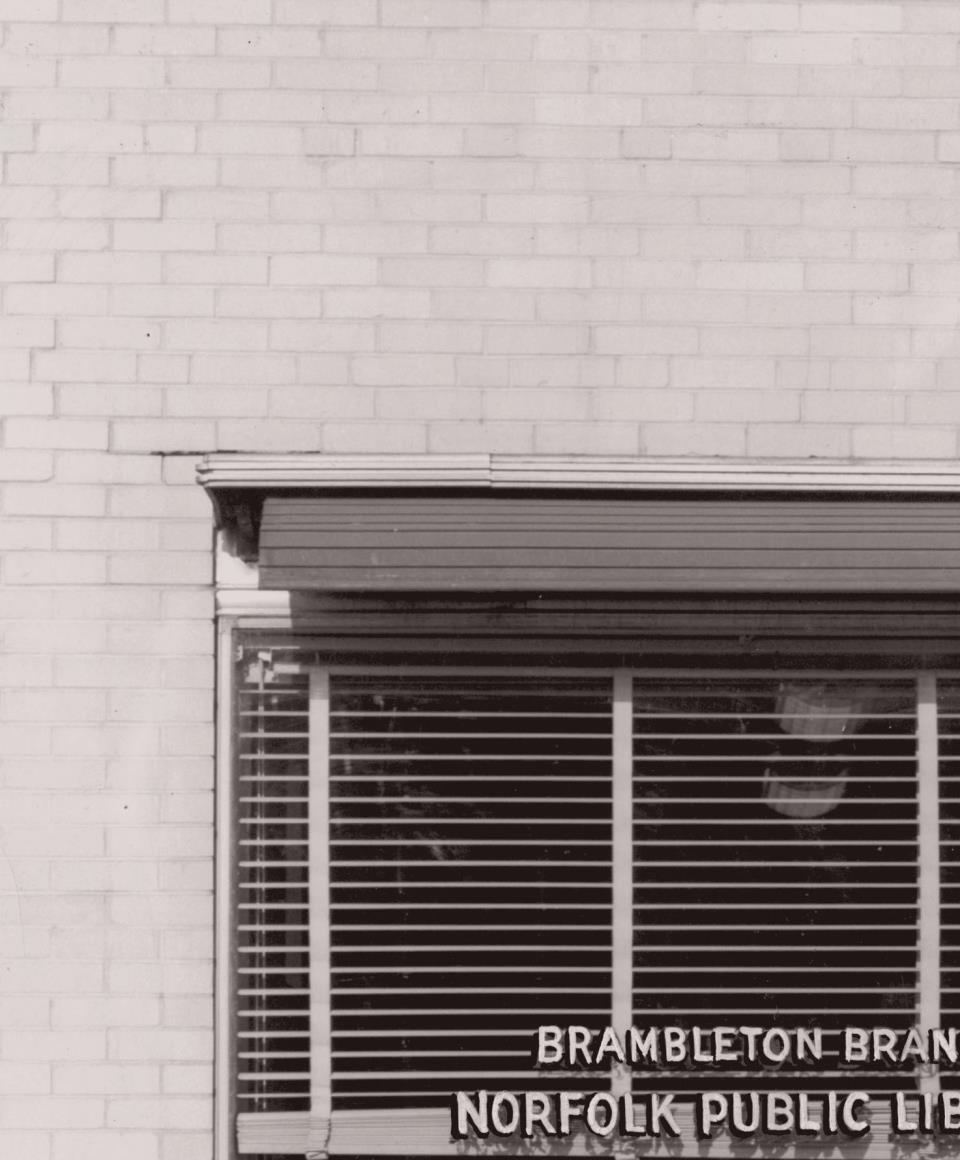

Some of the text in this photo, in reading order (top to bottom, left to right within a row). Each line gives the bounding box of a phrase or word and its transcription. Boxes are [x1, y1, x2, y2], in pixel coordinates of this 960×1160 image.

[536, 1025, 824, 1064] BRAMBLETON
[454, 1090, 684, 1138] NORFOLK
[700, 1090, 872, 1138] PUBLIC
